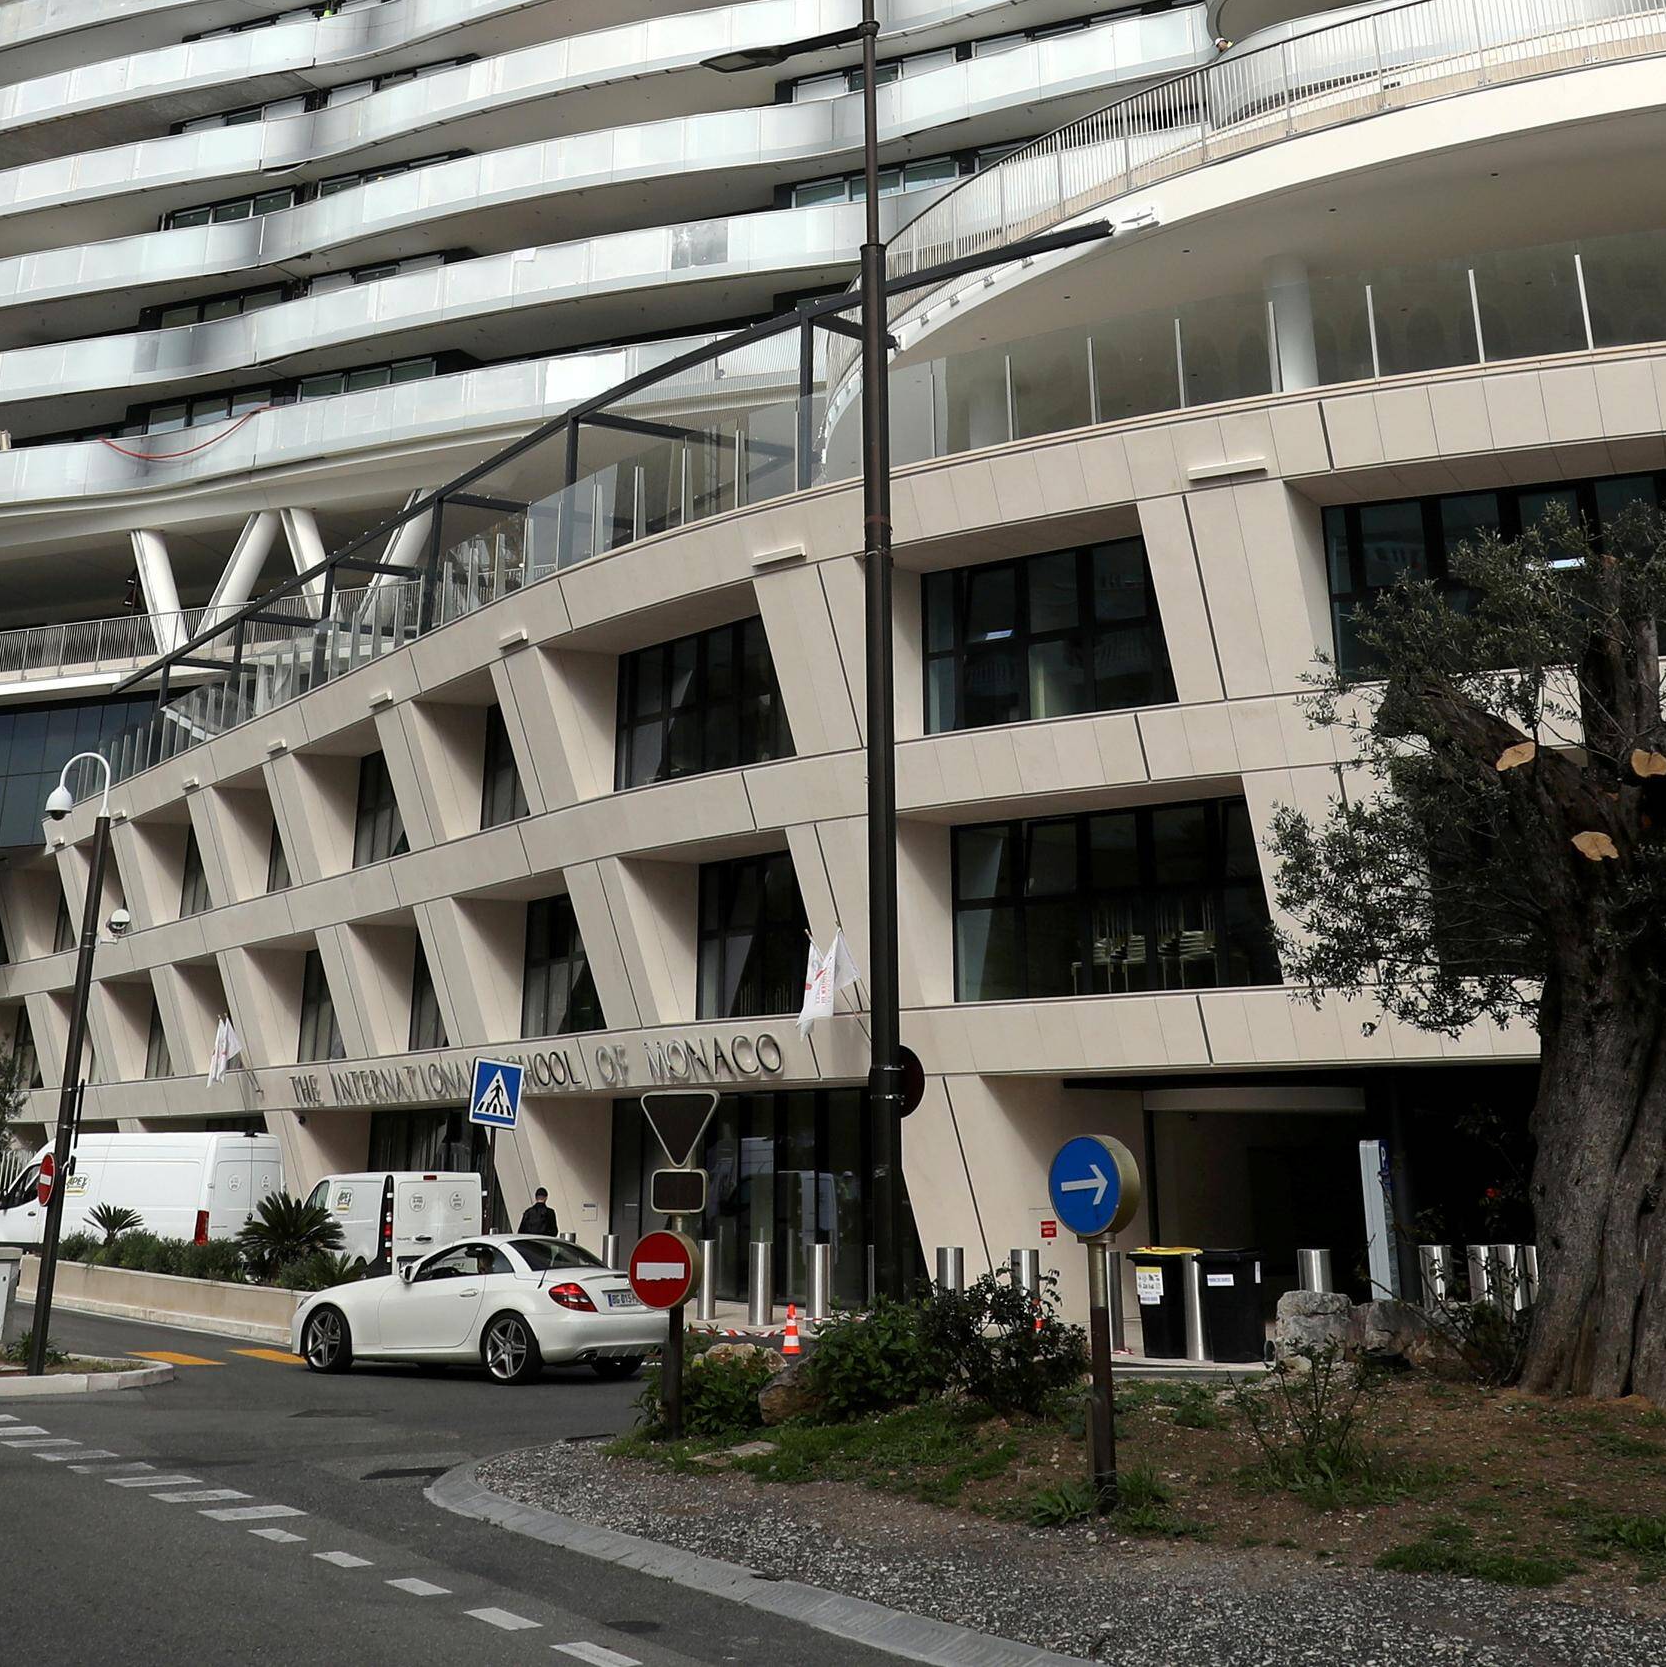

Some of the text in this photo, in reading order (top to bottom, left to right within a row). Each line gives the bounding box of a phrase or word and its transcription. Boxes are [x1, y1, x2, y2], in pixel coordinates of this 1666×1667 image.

[289, 1074, 321, 1103] THE
[595, 1043, 629, 1083] OF
[644, 1033, 782, 1080] MONACO
